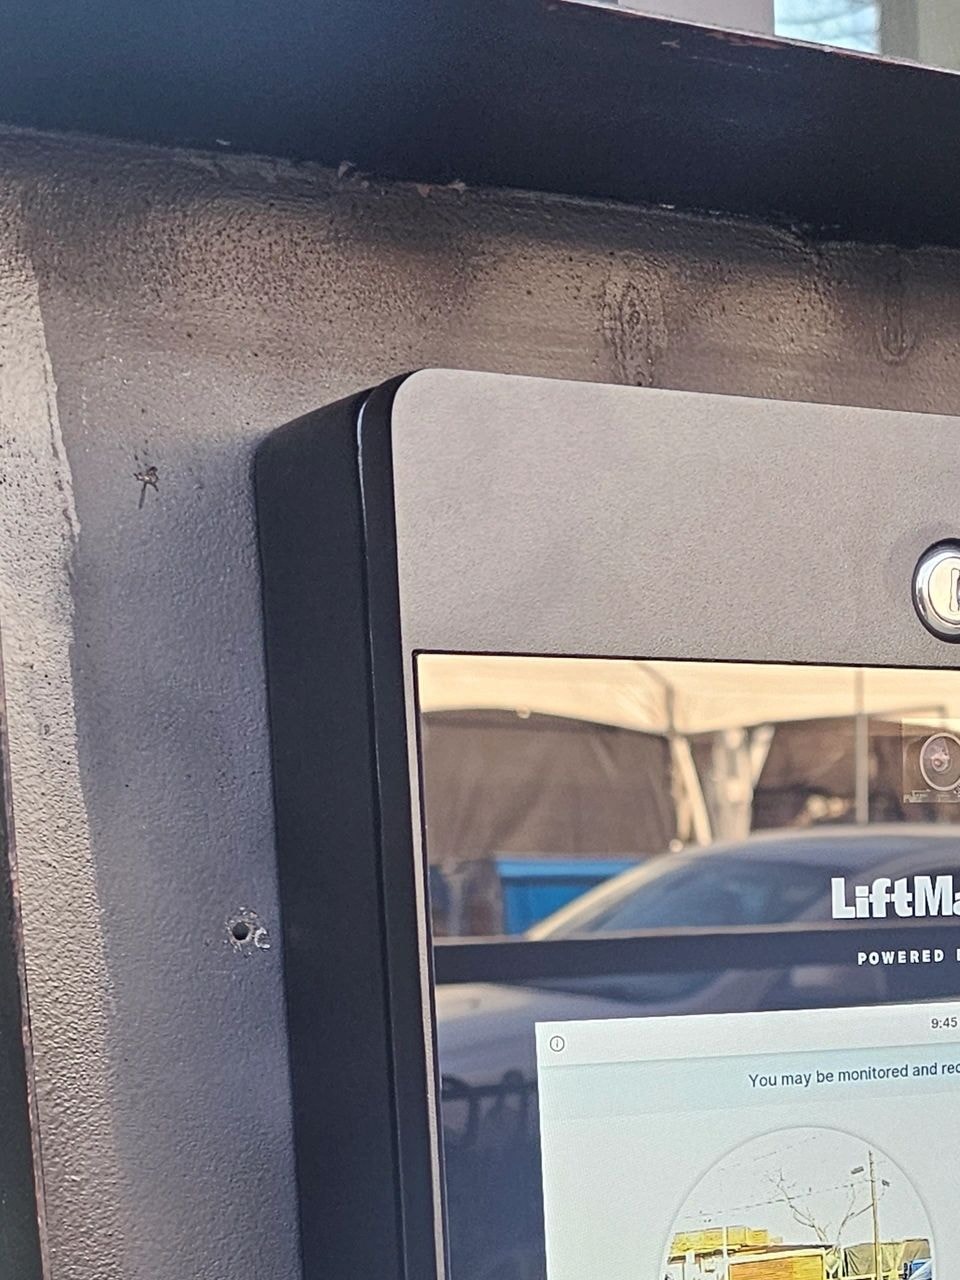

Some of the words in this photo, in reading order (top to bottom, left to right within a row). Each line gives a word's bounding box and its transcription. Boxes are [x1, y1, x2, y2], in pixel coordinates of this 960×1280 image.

[857, 949, 945, 966] POWERED
[931, 1017, 958, 1029] 9:45
[748, 1073, 778, 1088] You
[781, 1071, 812, 1087] may
[816, 1069, 834, 1083] be
[838, 1064, 909, 1082] monitored
[912, 1063, 938, 1077] and
